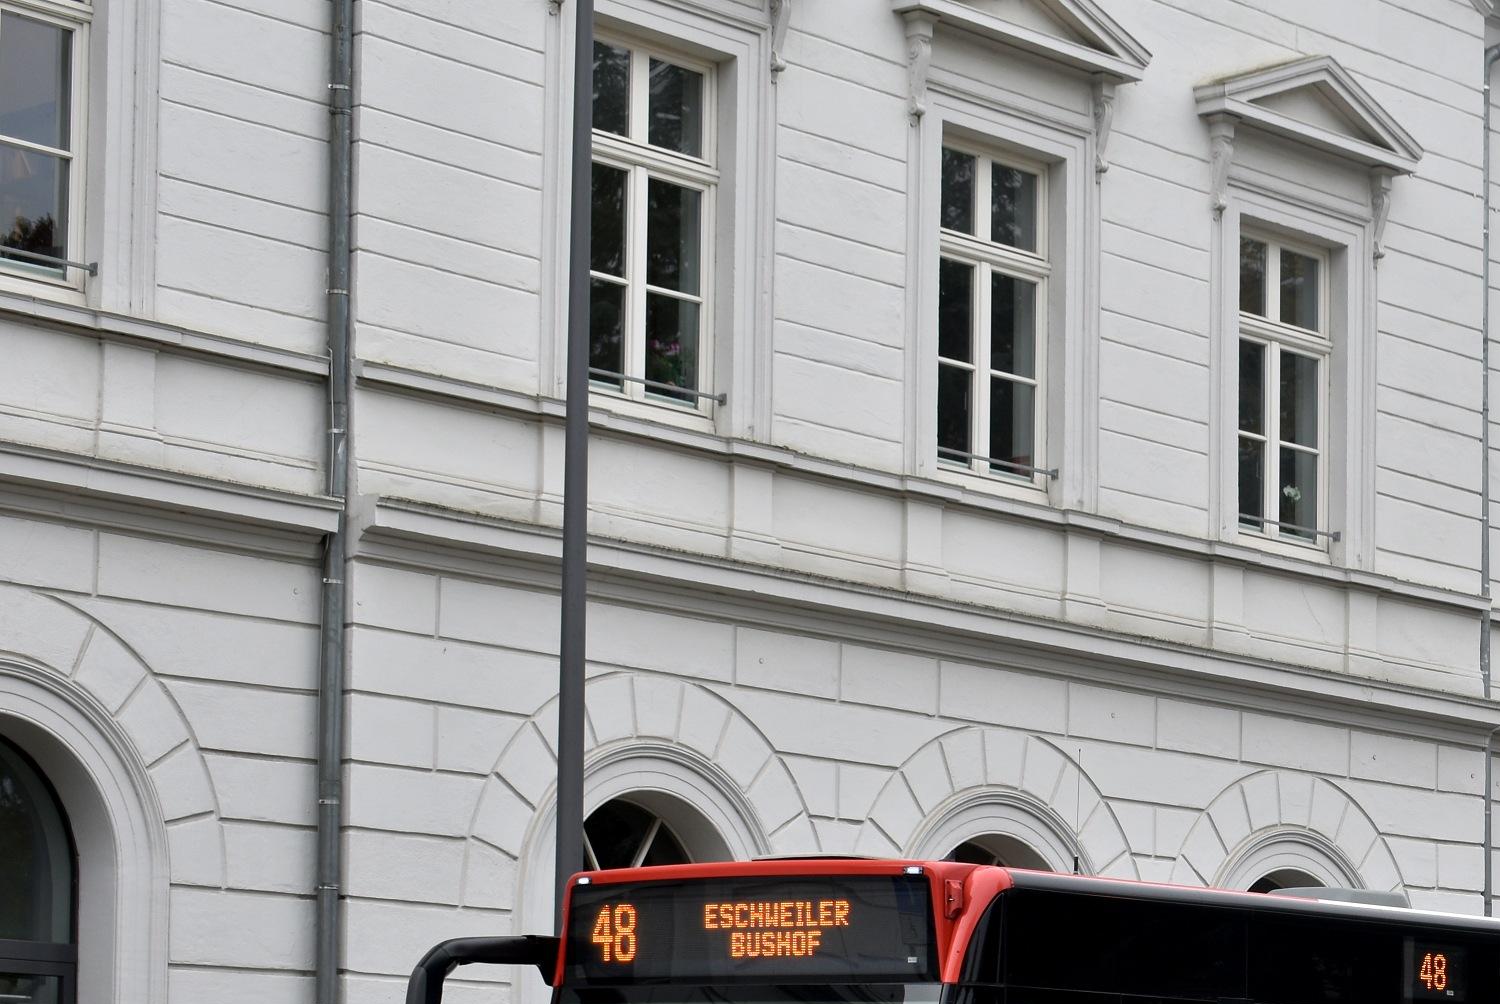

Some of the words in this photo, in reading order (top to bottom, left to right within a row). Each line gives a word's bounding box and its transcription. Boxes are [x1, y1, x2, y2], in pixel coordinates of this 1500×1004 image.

[705, 900, 849, 929] ESCHWEILER
[592, 903, 637, 962] 48
[731, 931, 821, 958] BUSHOF
[1421, 953, 1446, 990] 48
